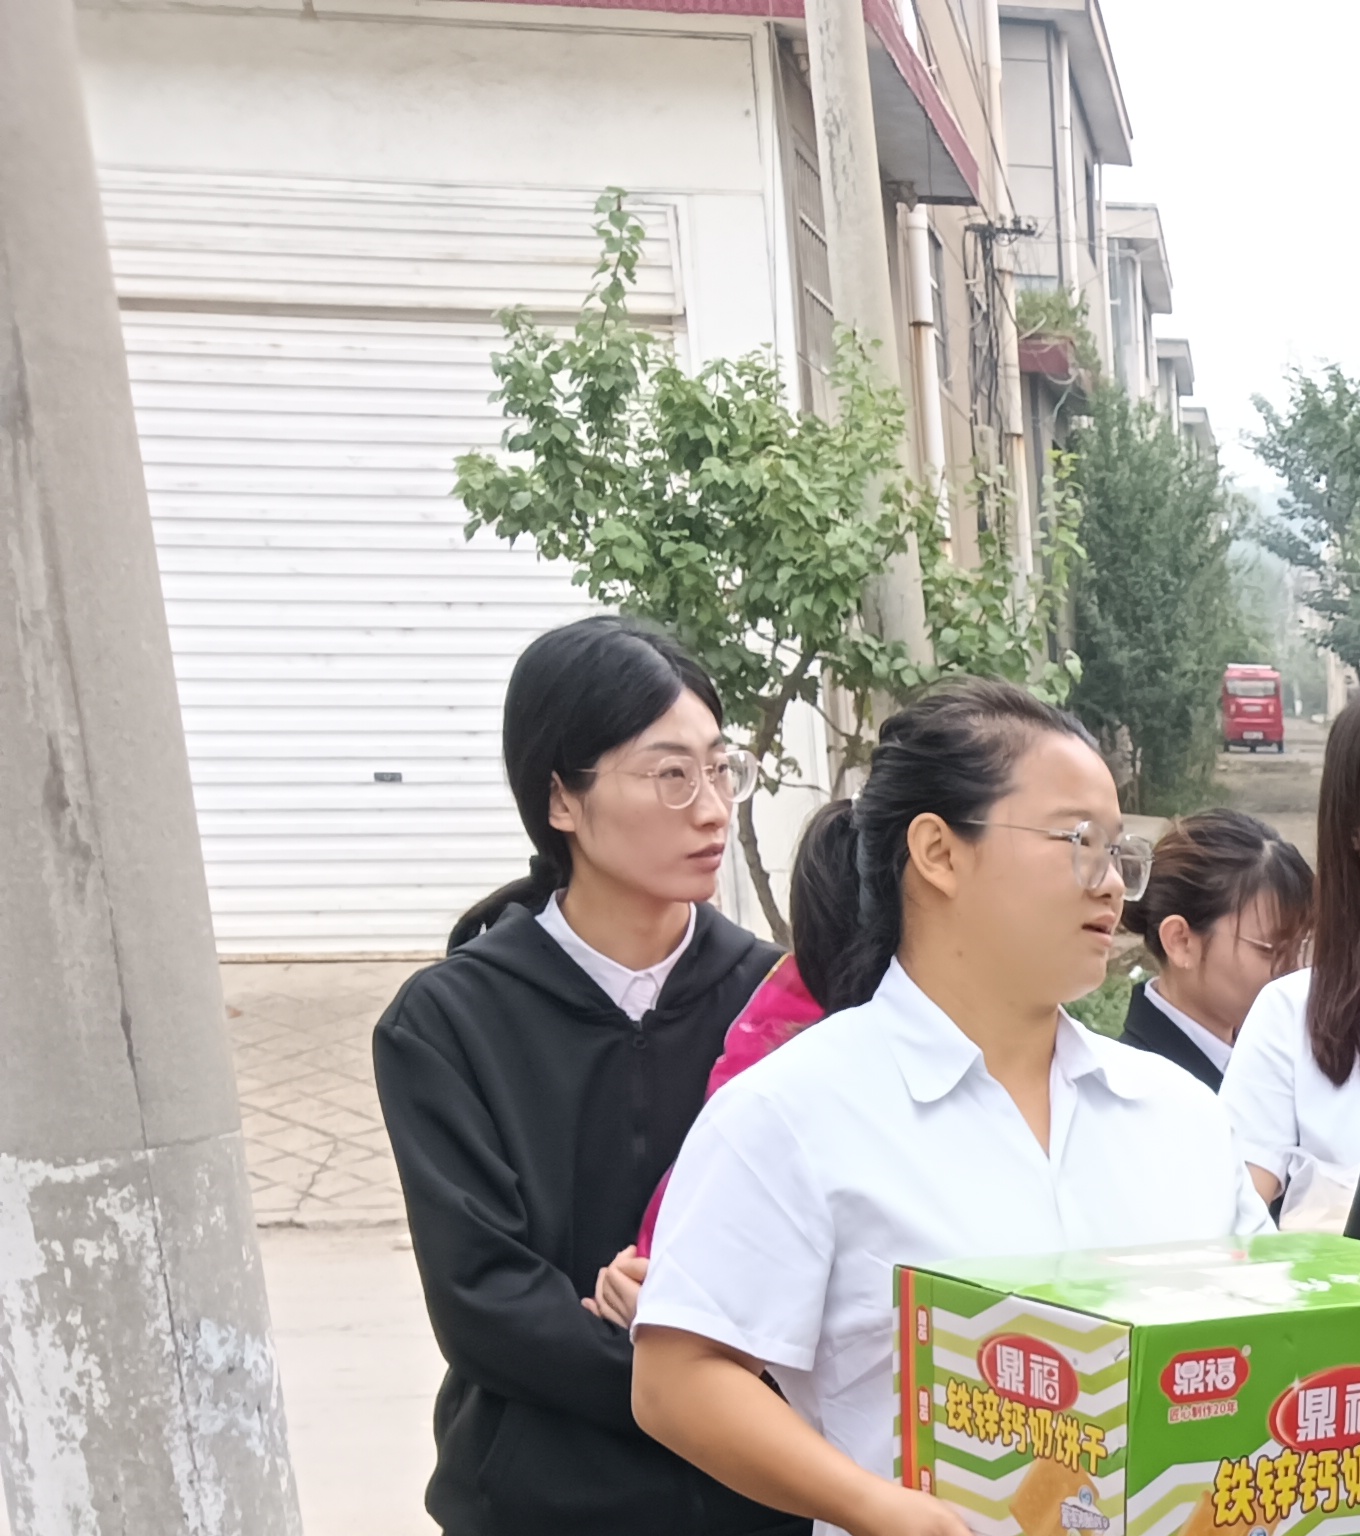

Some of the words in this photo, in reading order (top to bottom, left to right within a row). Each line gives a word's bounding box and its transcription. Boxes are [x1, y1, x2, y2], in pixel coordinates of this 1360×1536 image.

[996, 1344, 1060, 1405] 鼎福
[1173, 1357, 1237, 1395] 鼎福
[945, 1377, 1108, 1476] 铁锌钙奶饼干
